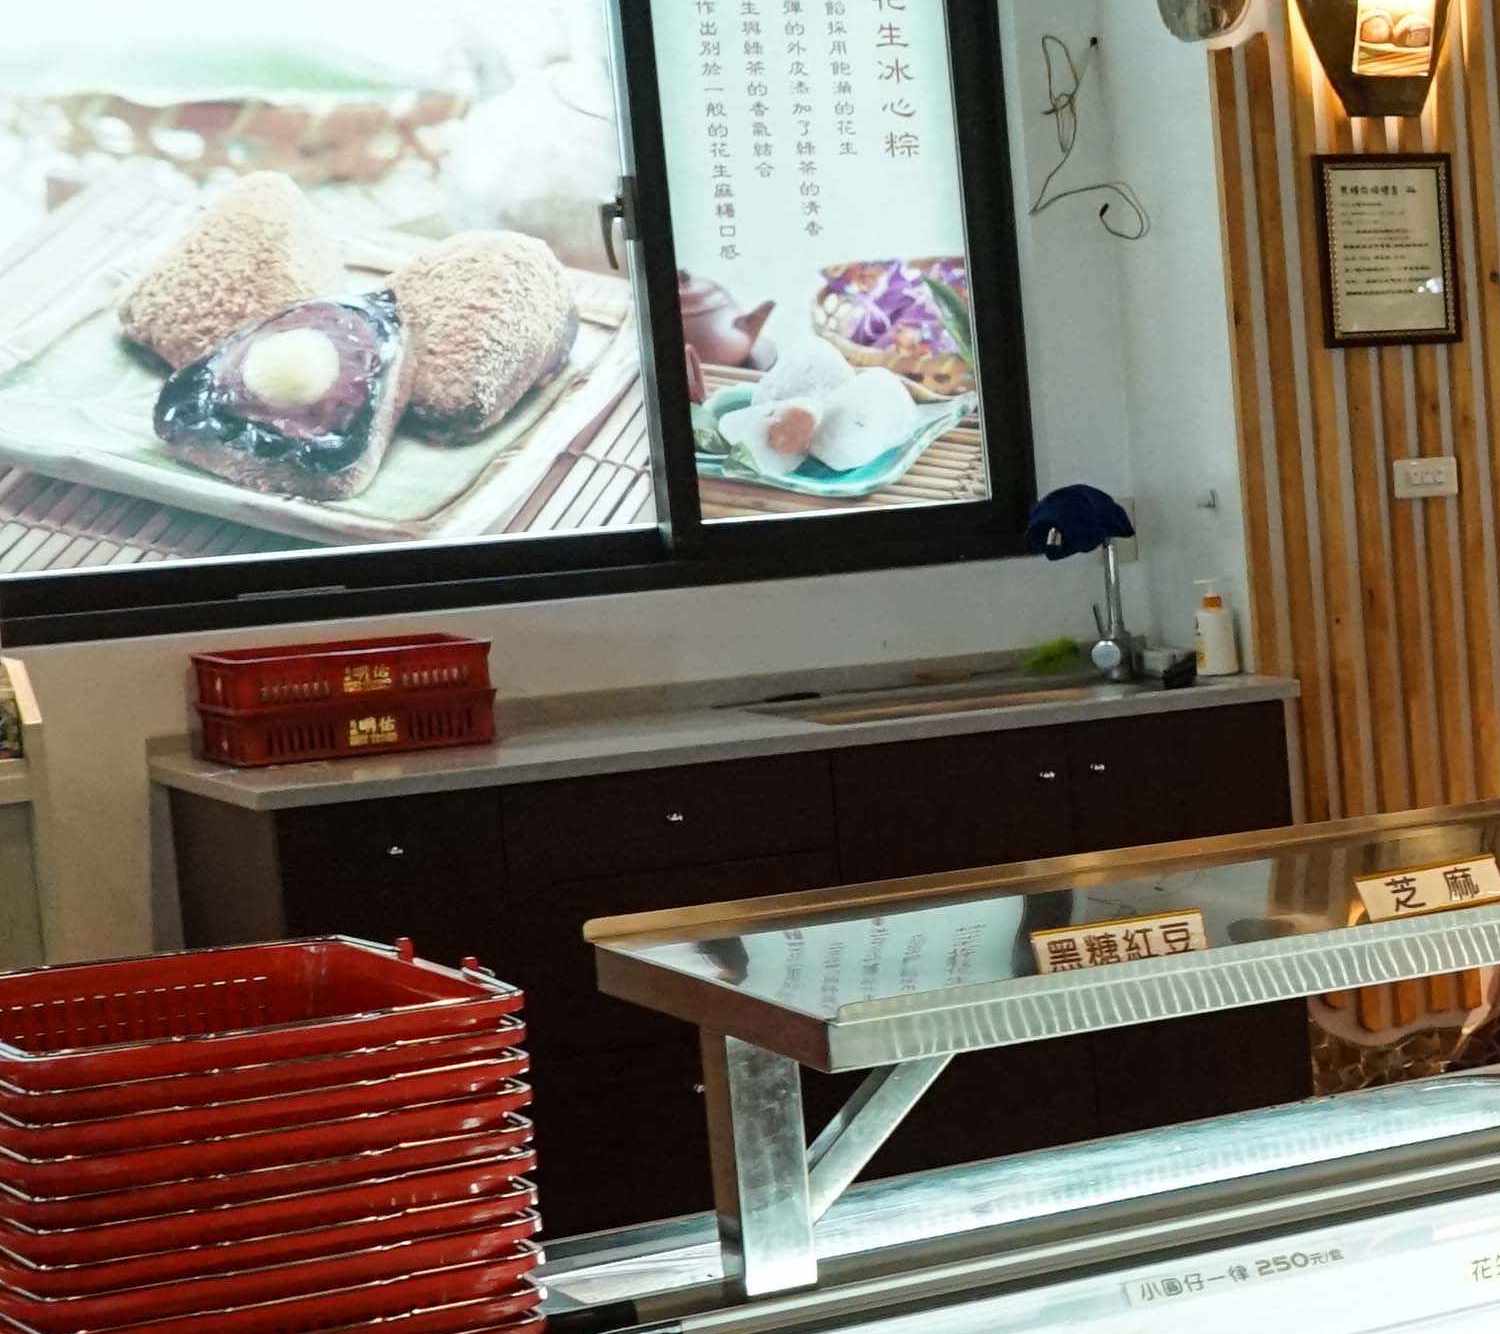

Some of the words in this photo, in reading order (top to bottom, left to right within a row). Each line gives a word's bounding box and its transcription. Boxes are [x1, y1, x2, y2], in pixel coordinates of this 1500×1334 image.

[1383, 866, 1480, 912] 芝麻
[1047, 921, 1196, 973] 黑糖紅豆
